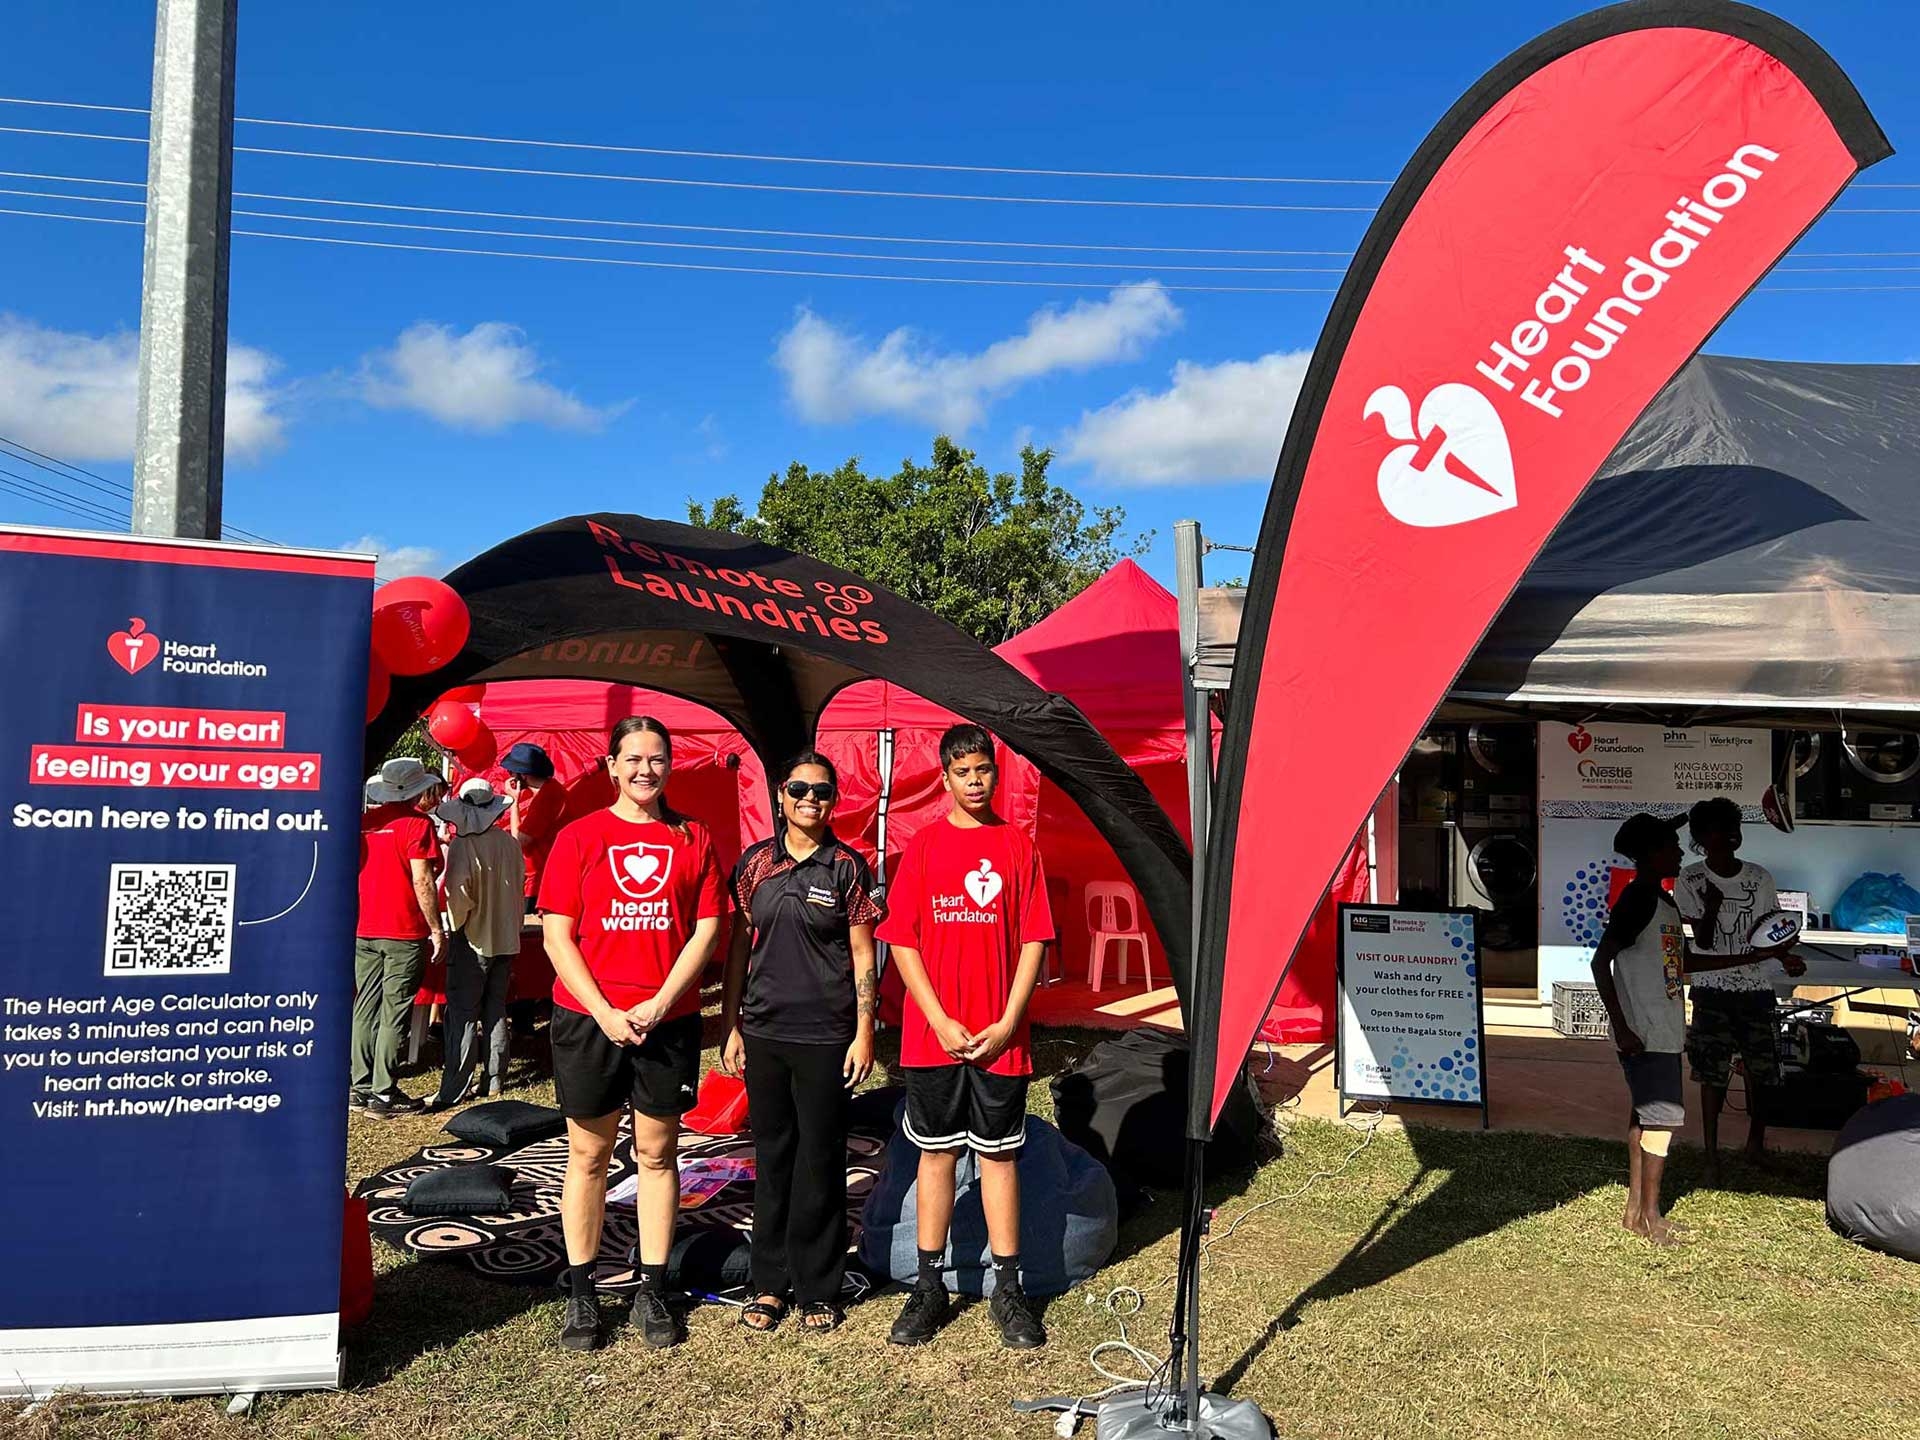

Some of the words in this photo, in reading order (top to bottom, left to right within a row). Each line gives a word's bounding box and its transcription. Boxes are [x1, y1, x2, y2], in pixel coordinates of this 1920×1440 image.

[1520, 143, 1780, 418] Foundation
[1475, 245, 1606, 392] Heart
[586, 519, 805, 598] Remote
[604, 555, 889, 644] Laundries
[163, 640, 217, 659] Heart
[163, 657, 267, 677] Foundation
[83, 711, 110, 737] Is
[119, 718, 190, 742] your
[198, 717, 281, 742] heart
[1593, 736, 1619, 744] Heart
[1663, 730, 1687, 743] phn
[1593, 744, 1644, 753] Foundation
[36, 752, 151, 787] feeling
[160, 762, 231, 786] your
[237, 760, 316, 790] age?
[1674, 771, 1743, 781] MALLESONS
[12, 803, 93, 828] Scan
[102, 805, 171, 830] here
[177, 807, 207, 830] to
[213, 807, 270, 831] find
[276, 809, 329, 831] out.
[611, 898, 669, 916] heart
[931, 893, 965, 909] Heart
[933, 906, 998, 924] Fundation
[1771, 922, 1795, 941] Pauls
[1356, 952, 1381, 961] VISIT
[1383, 954, 1405, 963] OUR
[1407, 956, 1458, 965] LAUNDRY!
[1374, 970, 1401, 980] Wash
[1403, 972, 1422, 982] and
[1424, 973, 1442, 984] dry
[1355, 986, 1379, 995] your
[1381, 986, 1418, 996] clothes
[1420, 988, 1436, 997] for
[1438, 990, 1464, 999] FREE
[4, 998, 41, 1015] The
[47, 996, 107, 1015] Heart
[111, 996, 155, 1017] Age
[160, 993, 271, 1013] Calculator
[275, 991, 319, 1011] only
[1370, 1009, 1393, 1018] Open
[1394, 1010, 1413, 1019] 9am
[1425, 1012, 1444, 1021] 6pm
[4, 1023, 62, 1041] takes
[67, 1022, 80, 1040] 3
[86, 1020, 170, 1039] minutes
[176, 1018, 219, 1036] and
[223, 1020, 264, 1035] can
[269, 1016, 315, 1035] help
[1360, 1024, 1380, 1032] Next
[1381, 1025, 1391, 1033] to
[1392, 1026, 1406, 1034] the
[1407, 1027, 1437, 1037] Bagala
[1438, 1028, 1462, 1037] Store
[4, 1053, 44, 1071] you
[50, 1049, 72, 1066] to
[77, 1045, 200, 1066] understand
[205, 1045, 252, 1064] your
[256, 1040, 288, 1058] risk
[293, 1040, 314, 1057] of
[44, 1073, 102, 1092] heart
[107, 1071, 176, 1090] attack
[181, 1072, 203, 1087] or
[207, 1068, 273, 1086] stroke.
[33, 1100, 79, 1119] Visit:
[84, 1093, 282, 1118] hrt.how/heart-age
